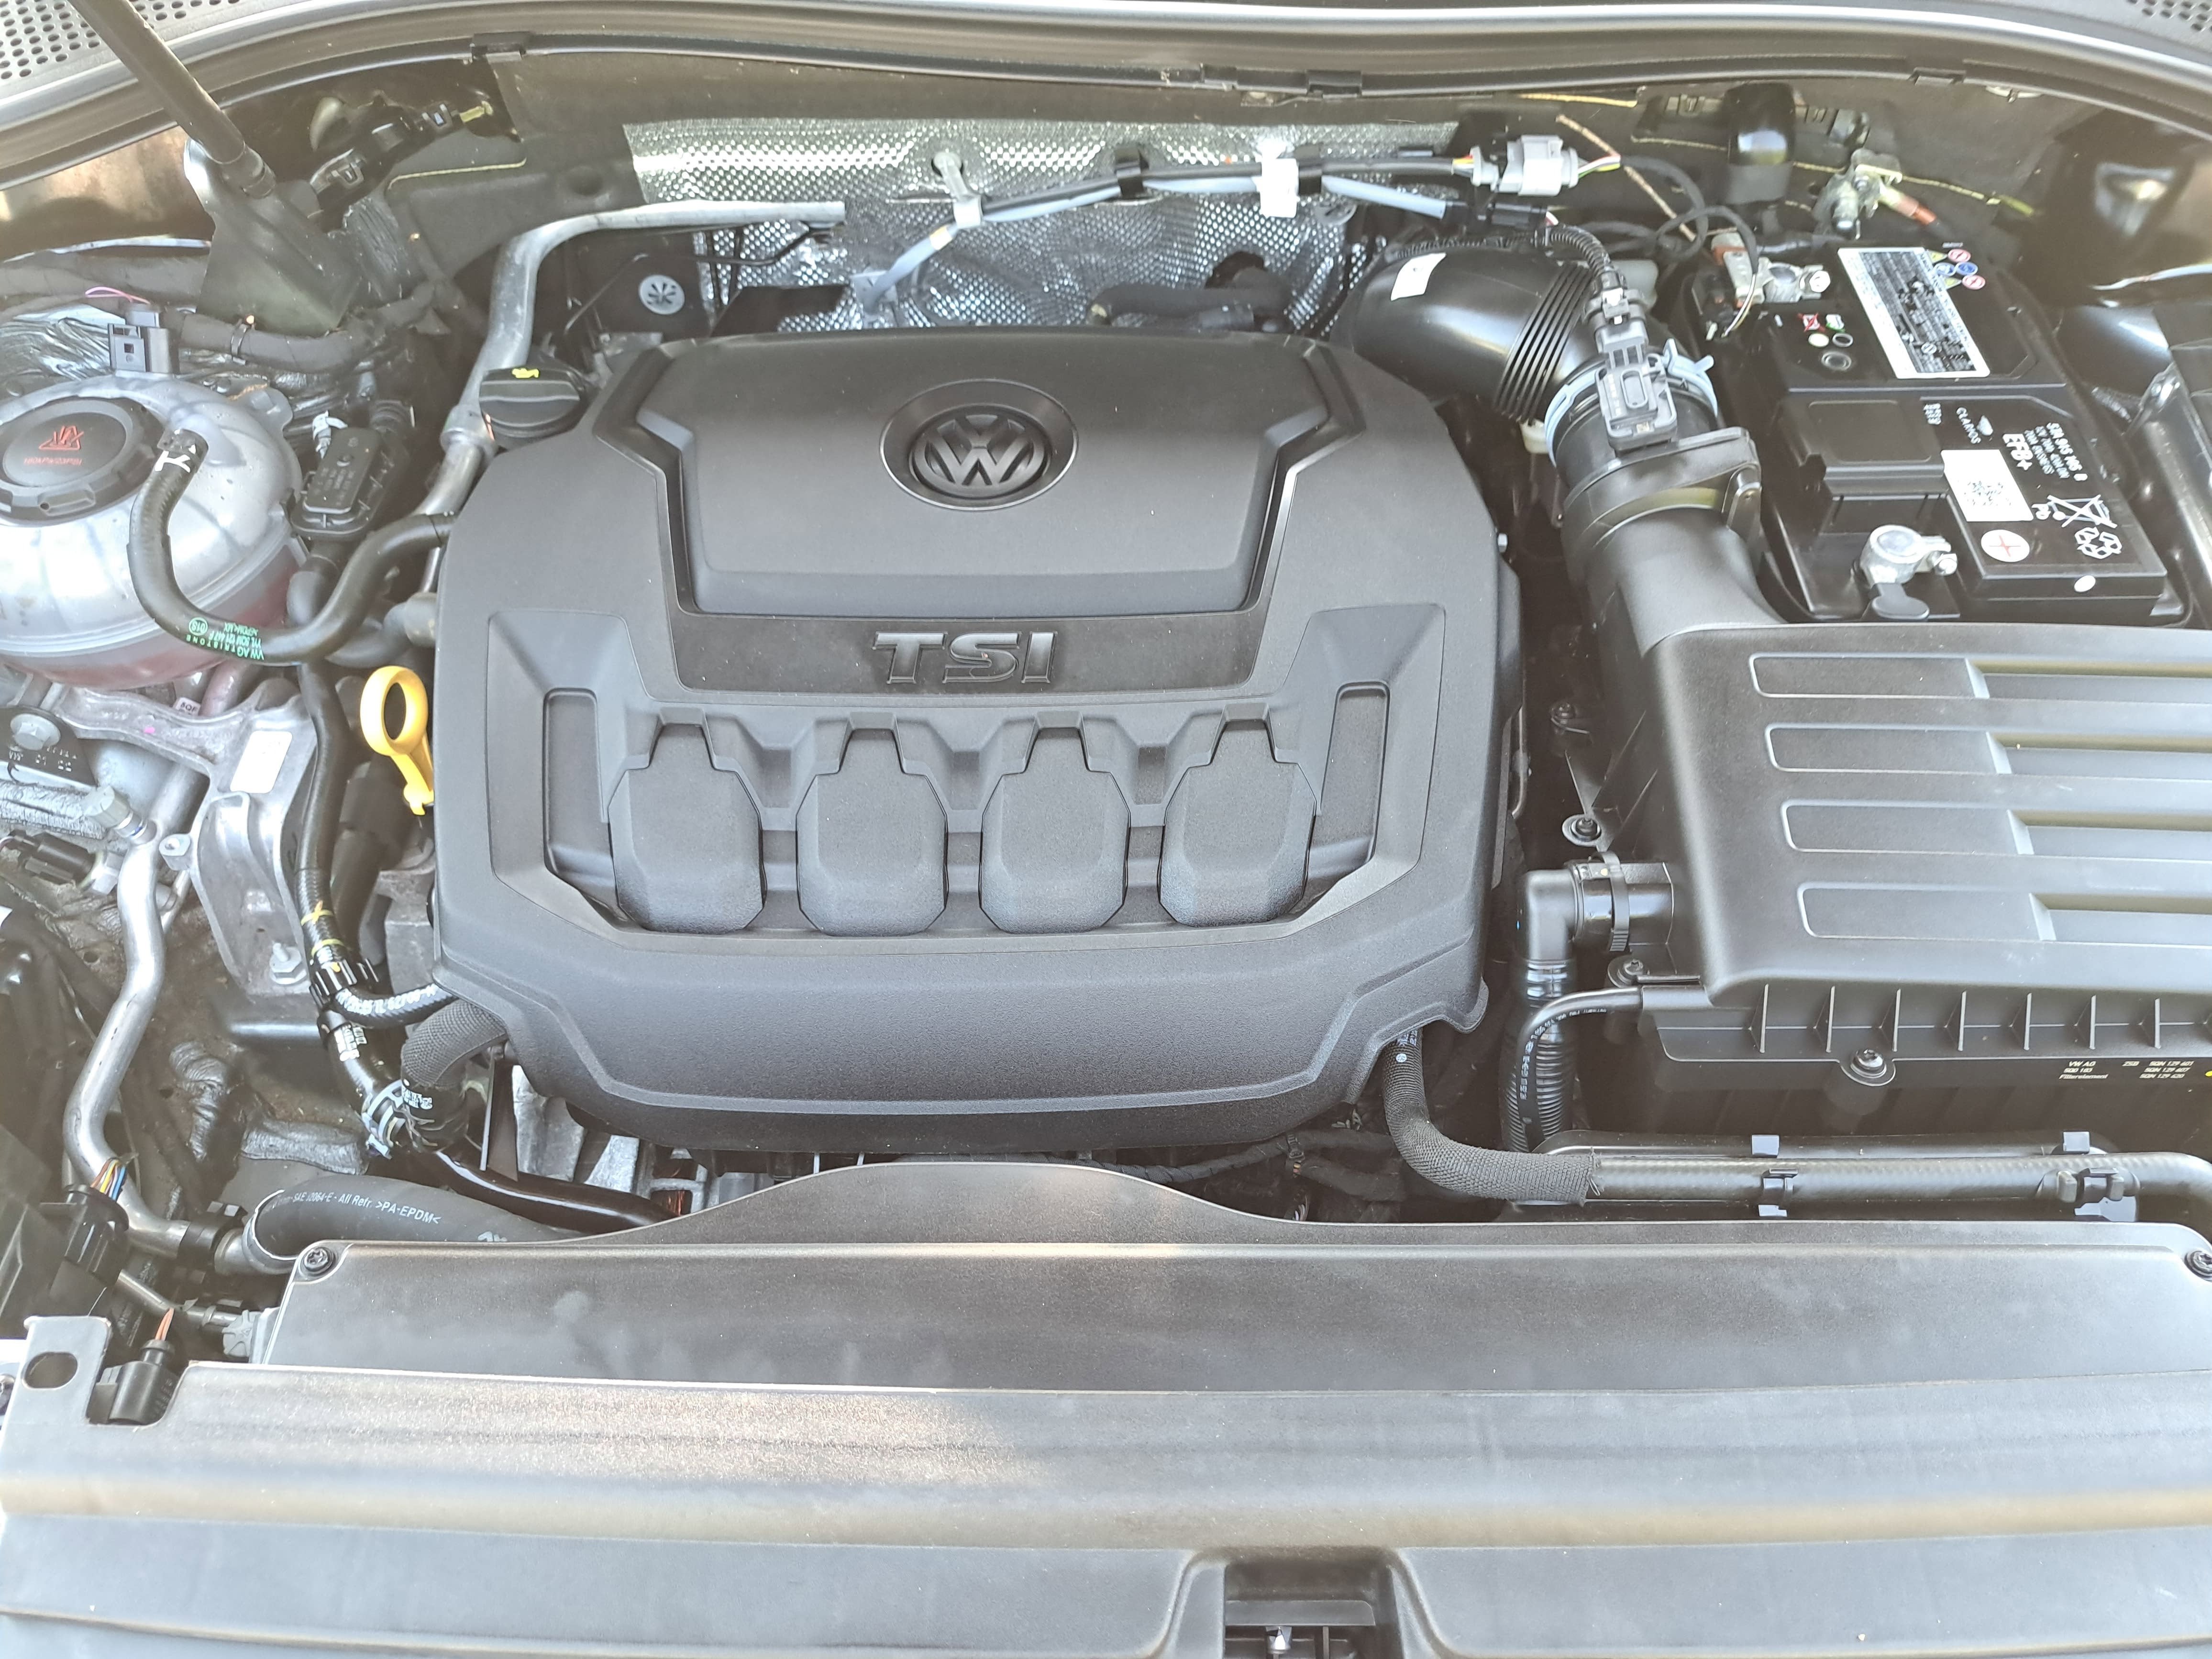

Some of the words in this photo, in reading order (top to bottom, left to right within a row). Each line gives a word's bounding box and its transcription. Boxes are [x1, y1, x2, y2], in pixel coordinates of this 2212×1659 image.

[872, 630, 1058, 684] TSI
[338, 1193, 353, 1205] All
[376, 1201, 442, 1224] >PA-EPDM<
